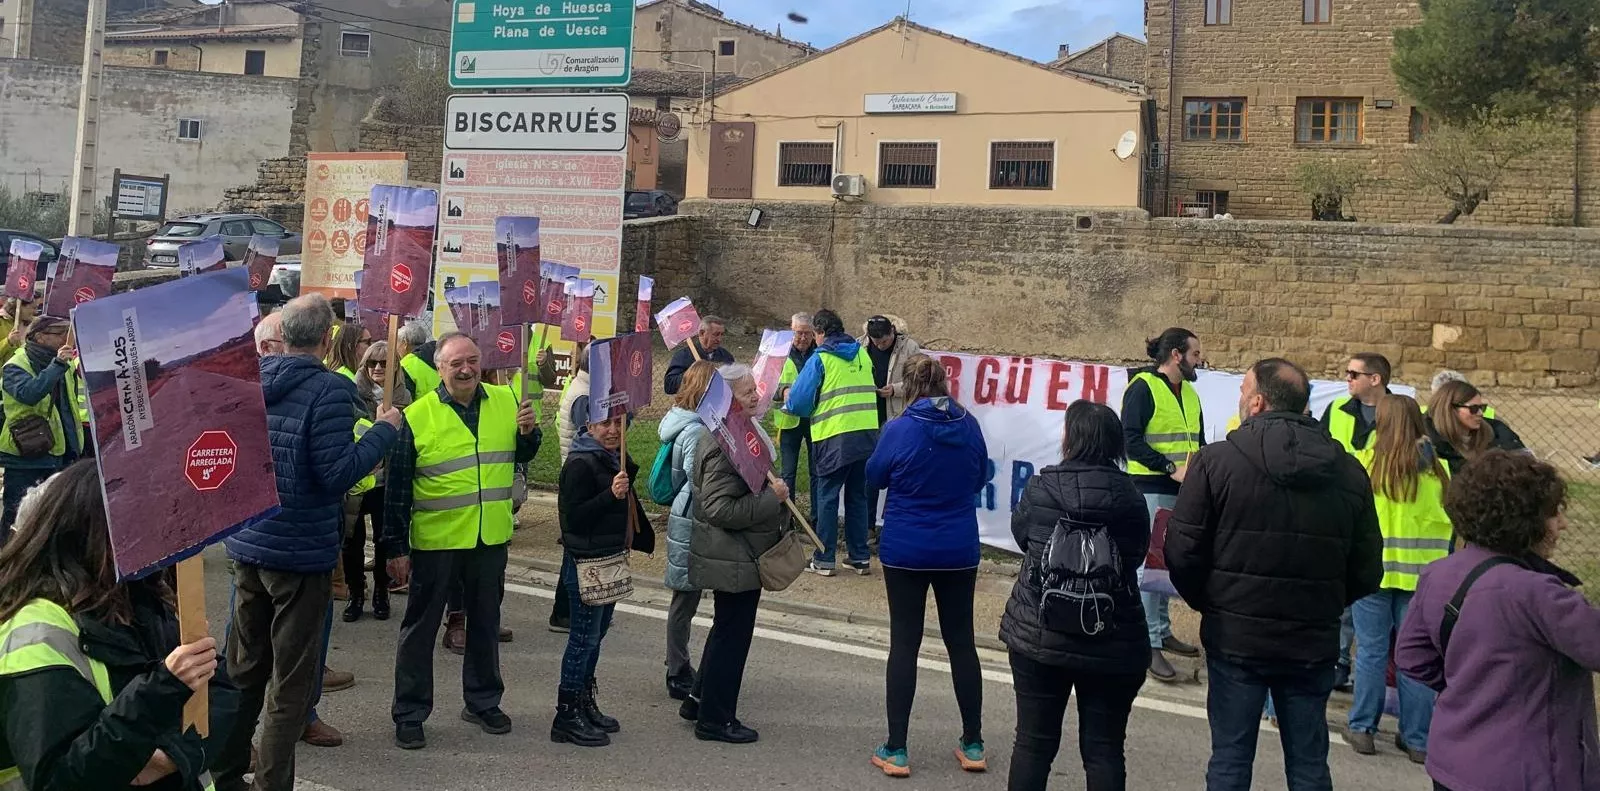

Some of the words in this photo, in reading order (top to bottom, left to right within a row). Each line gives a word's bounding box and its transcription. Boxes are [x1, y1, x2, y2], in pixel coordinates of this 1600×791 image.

[493, 4, 525, 18] Hoya
[535, 4, 551, 15] de
[562, 1, 612, 14] Huesca
[494, 26, 529, 38] Plana
[539, 25, 556, 37] de
[566, 23, 607, 36] Uesca
[565, 56, 619, 65] Comarcalización
[563, 64, 573, 72] de
[574, 64, 599, 74] Aragón
[455, 107, 617, 133] BISCARRUÉS
[495, 159, 528, 170] Iglesia
[486, 173, 497, 184] La
[191, 447, 233, 458] CARRETERA
[190, 457, 232, 467] ARREGLADA
